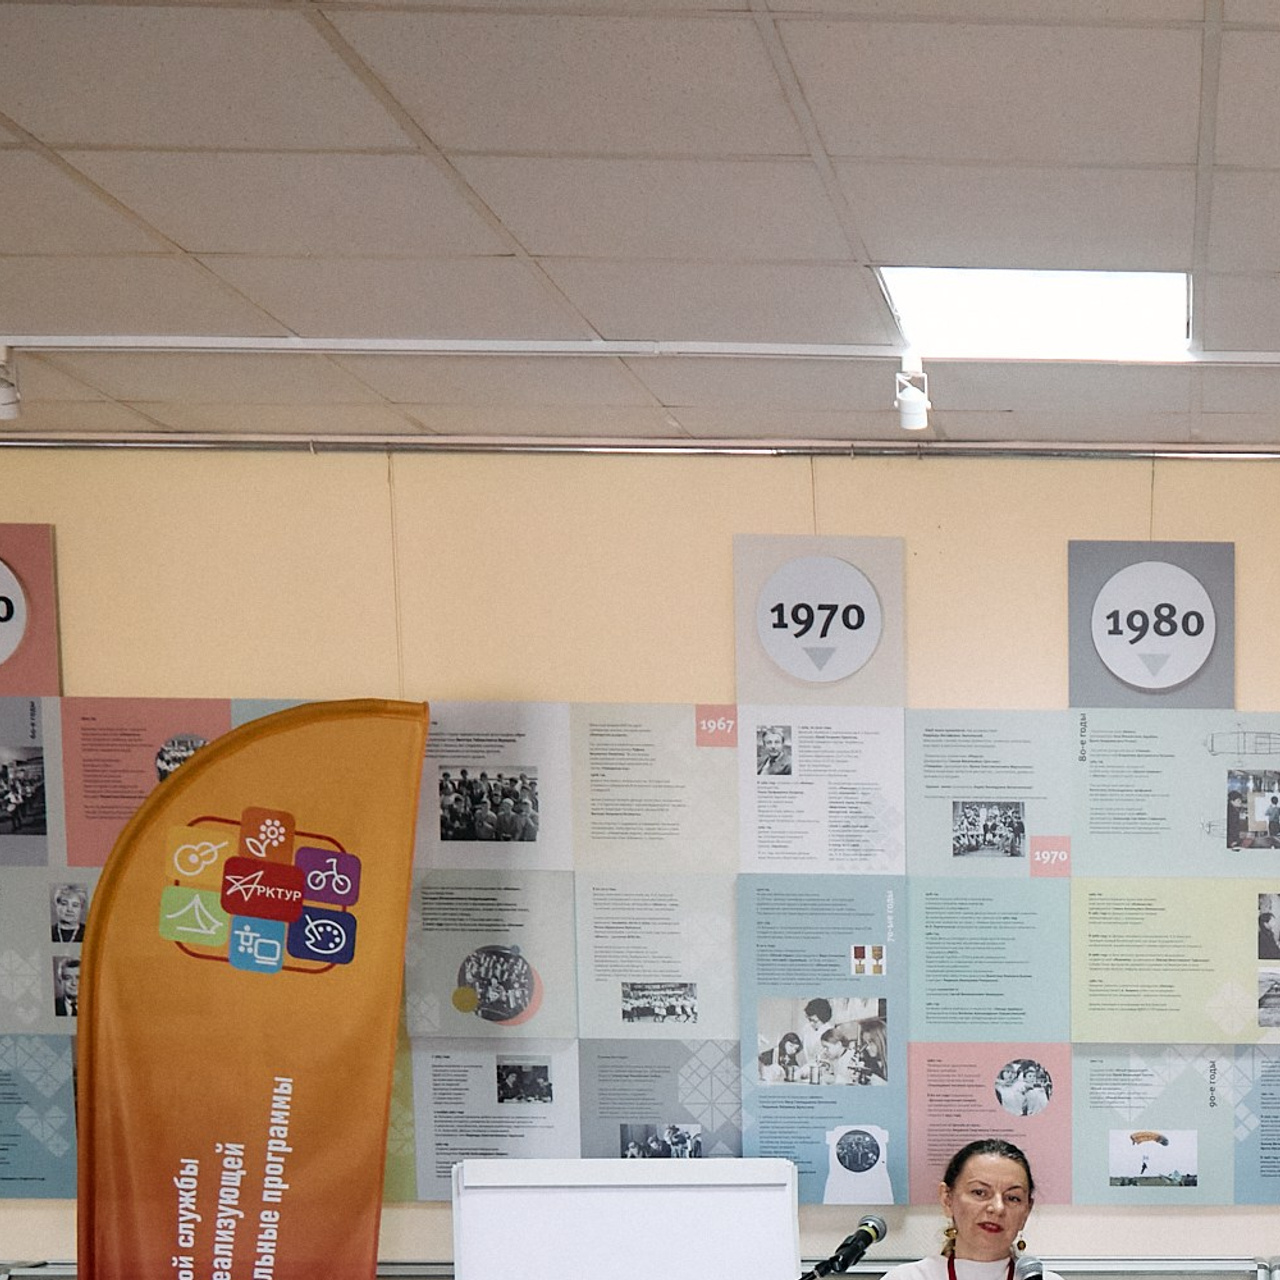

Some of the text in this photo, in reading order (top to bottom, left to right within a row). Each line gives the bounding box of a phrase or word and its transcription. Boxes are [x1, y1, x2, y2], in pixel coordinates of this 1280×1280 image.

[770, 600, 866, 640] 1970
[1105, 603, 1205, 644] 1980
[700, 718, 735, 734] 1967
[1079, 713, 1088, 737] годы
[1034, 850, 1068, 865] 1970
[263, 1076, 294, 1202] программы
[178, 1158, 199, 1249] службы
